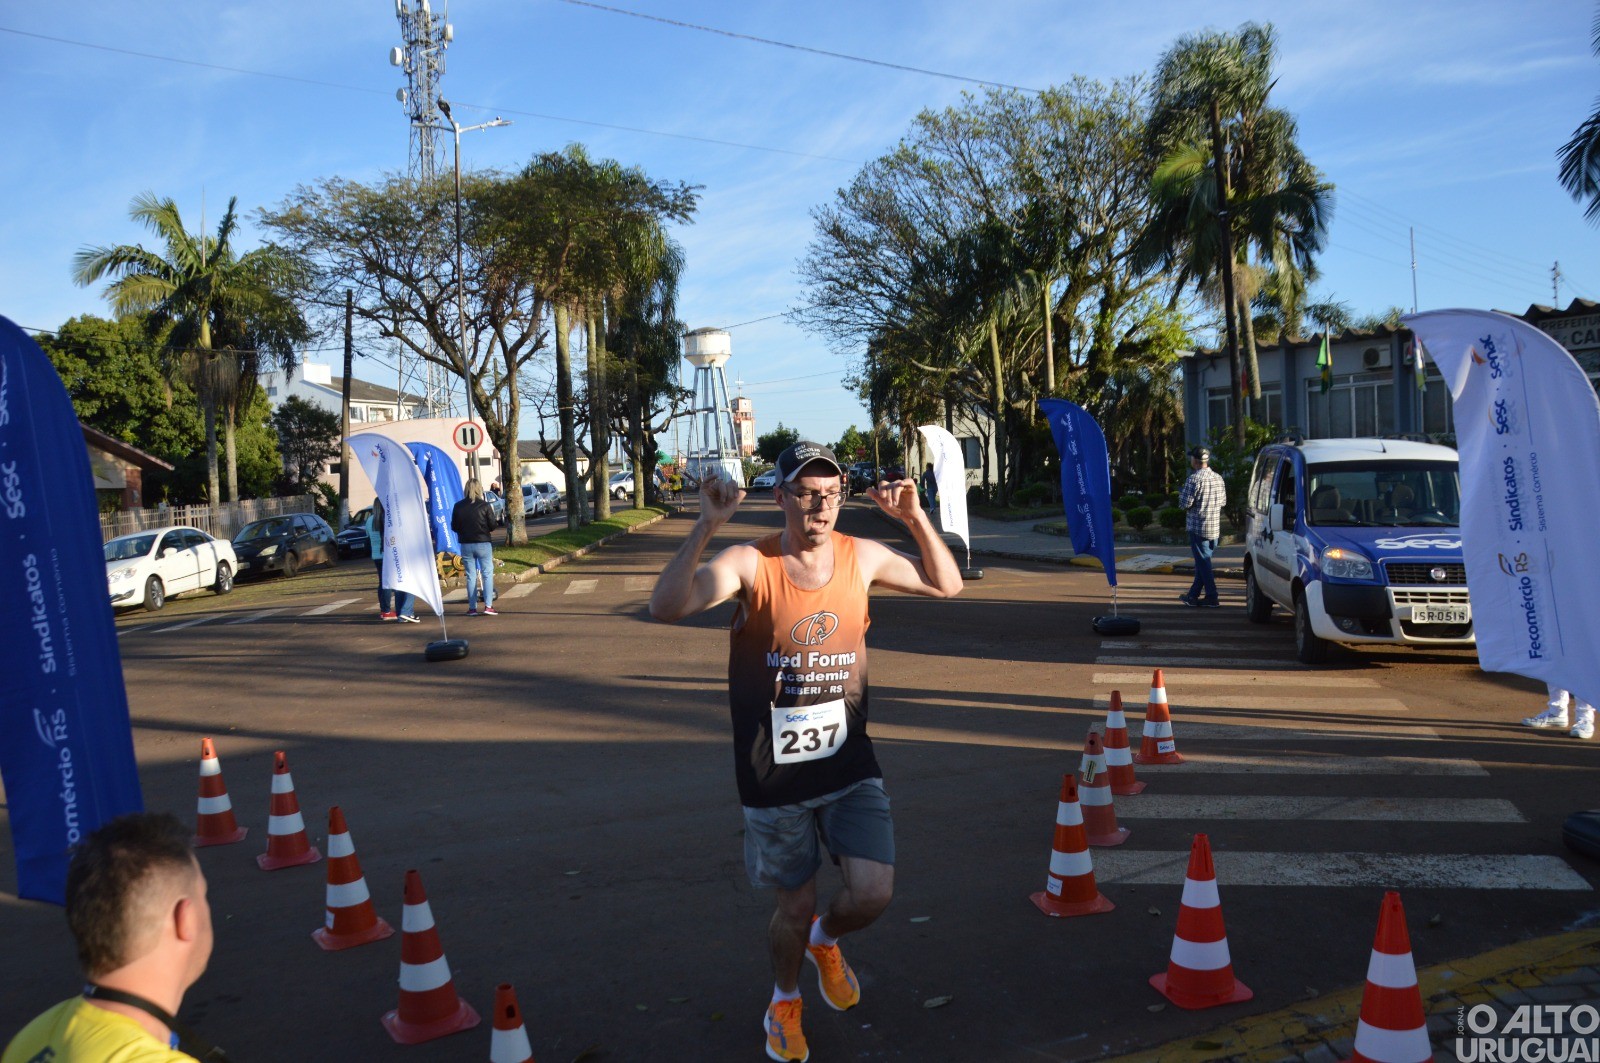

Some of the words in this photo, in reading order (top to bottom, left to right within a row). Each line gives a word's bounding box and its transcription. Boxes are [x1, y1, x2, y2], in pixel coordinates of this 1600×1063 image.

[1541, 314, 1600, 331] PREFEITU
[1571, 327, 1600, 346] CA
[1530, 452, 1541, 493] Comércio
[1503, 456, 1523, 532] Sindicatos
[1536, 494, 1547, 532] Sistema
[1374, 537, 1462, 550] Ses
[1513, 552, 1529, 573] RS
[1518, 576, 1543, 659] Fecomércio
[766, 652, 802, 668] Med
[808, 651, 856, 668] Forma
[775, 670, 850, 682] Academia
[784, 686, 822, 695] SEBERI
[829, 685, 843, 694] RS
[51, 708, 68, 741] RS
[779, 723, 840, 755] 237
[58, 747, 81, 850] omércio
